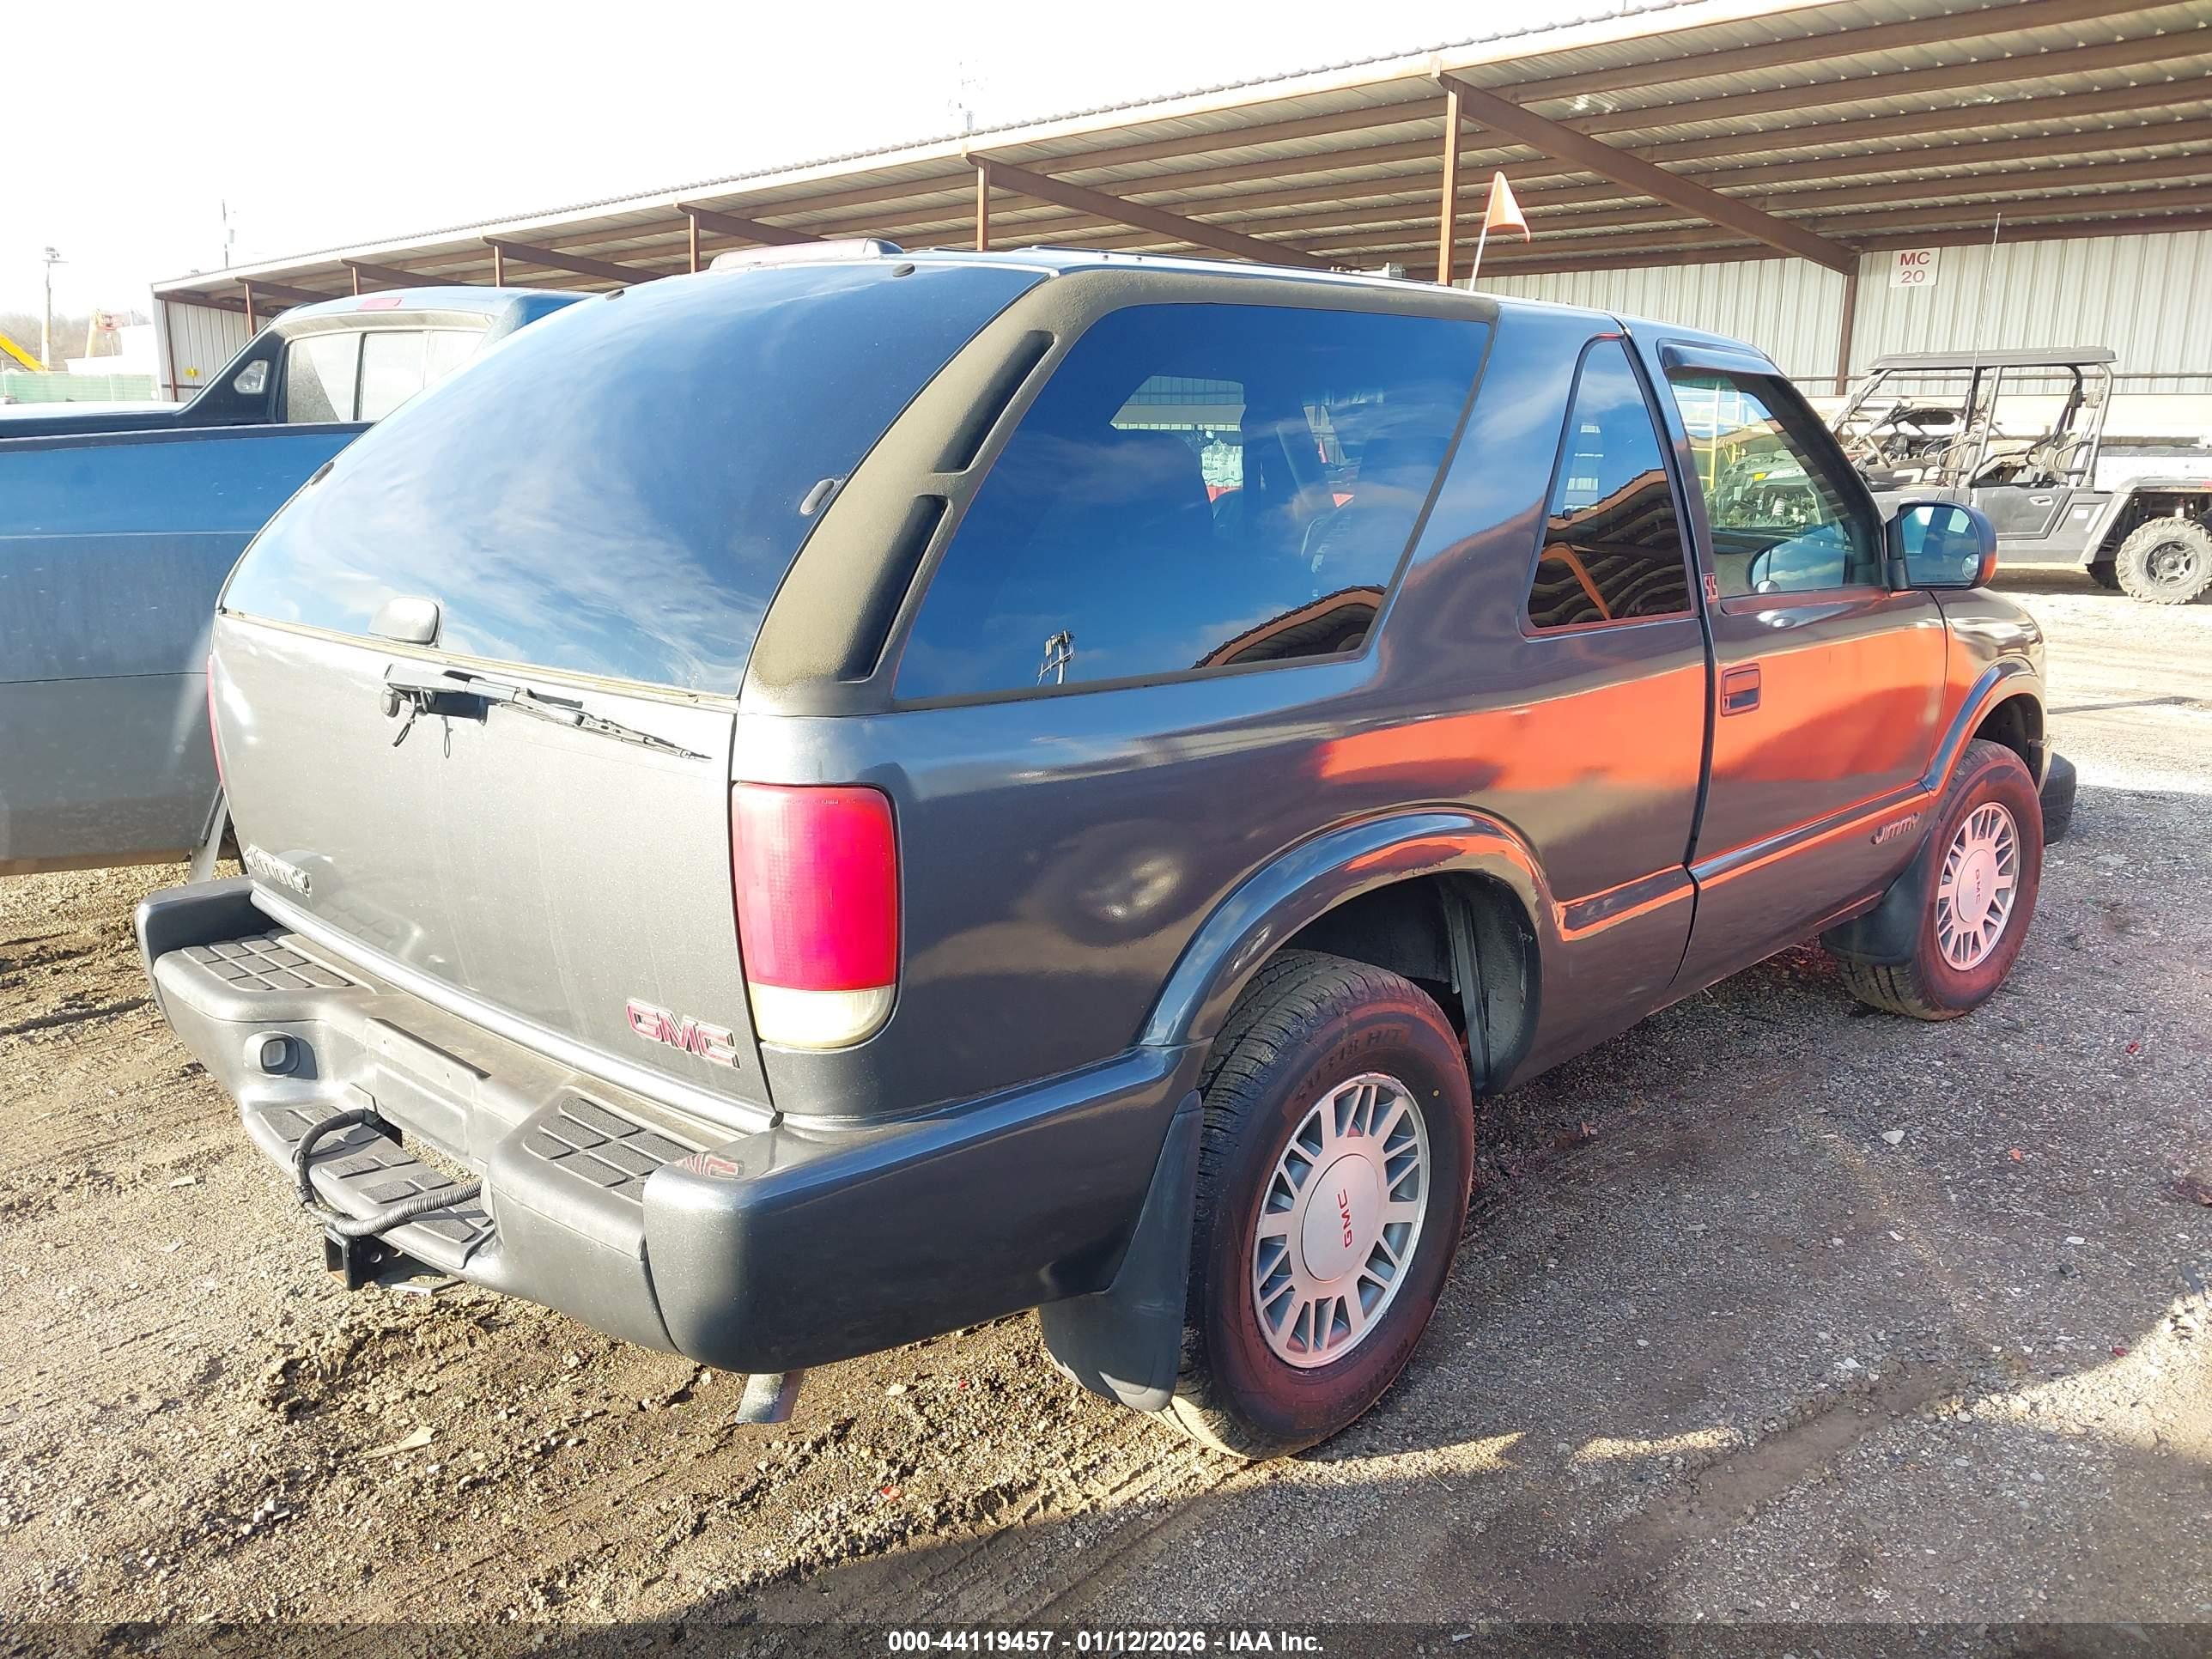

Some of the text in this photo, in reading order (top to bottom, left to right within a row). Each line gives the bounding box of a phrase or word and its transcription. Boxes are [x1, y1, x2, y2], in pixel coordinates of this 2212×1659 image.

[1899, 252, 1931, 266] MC
[1900, 270, 1925, 283] 20
[626, 998, 741, 1070] GMC
[1337, 1188, 1352, 1249] GMC
